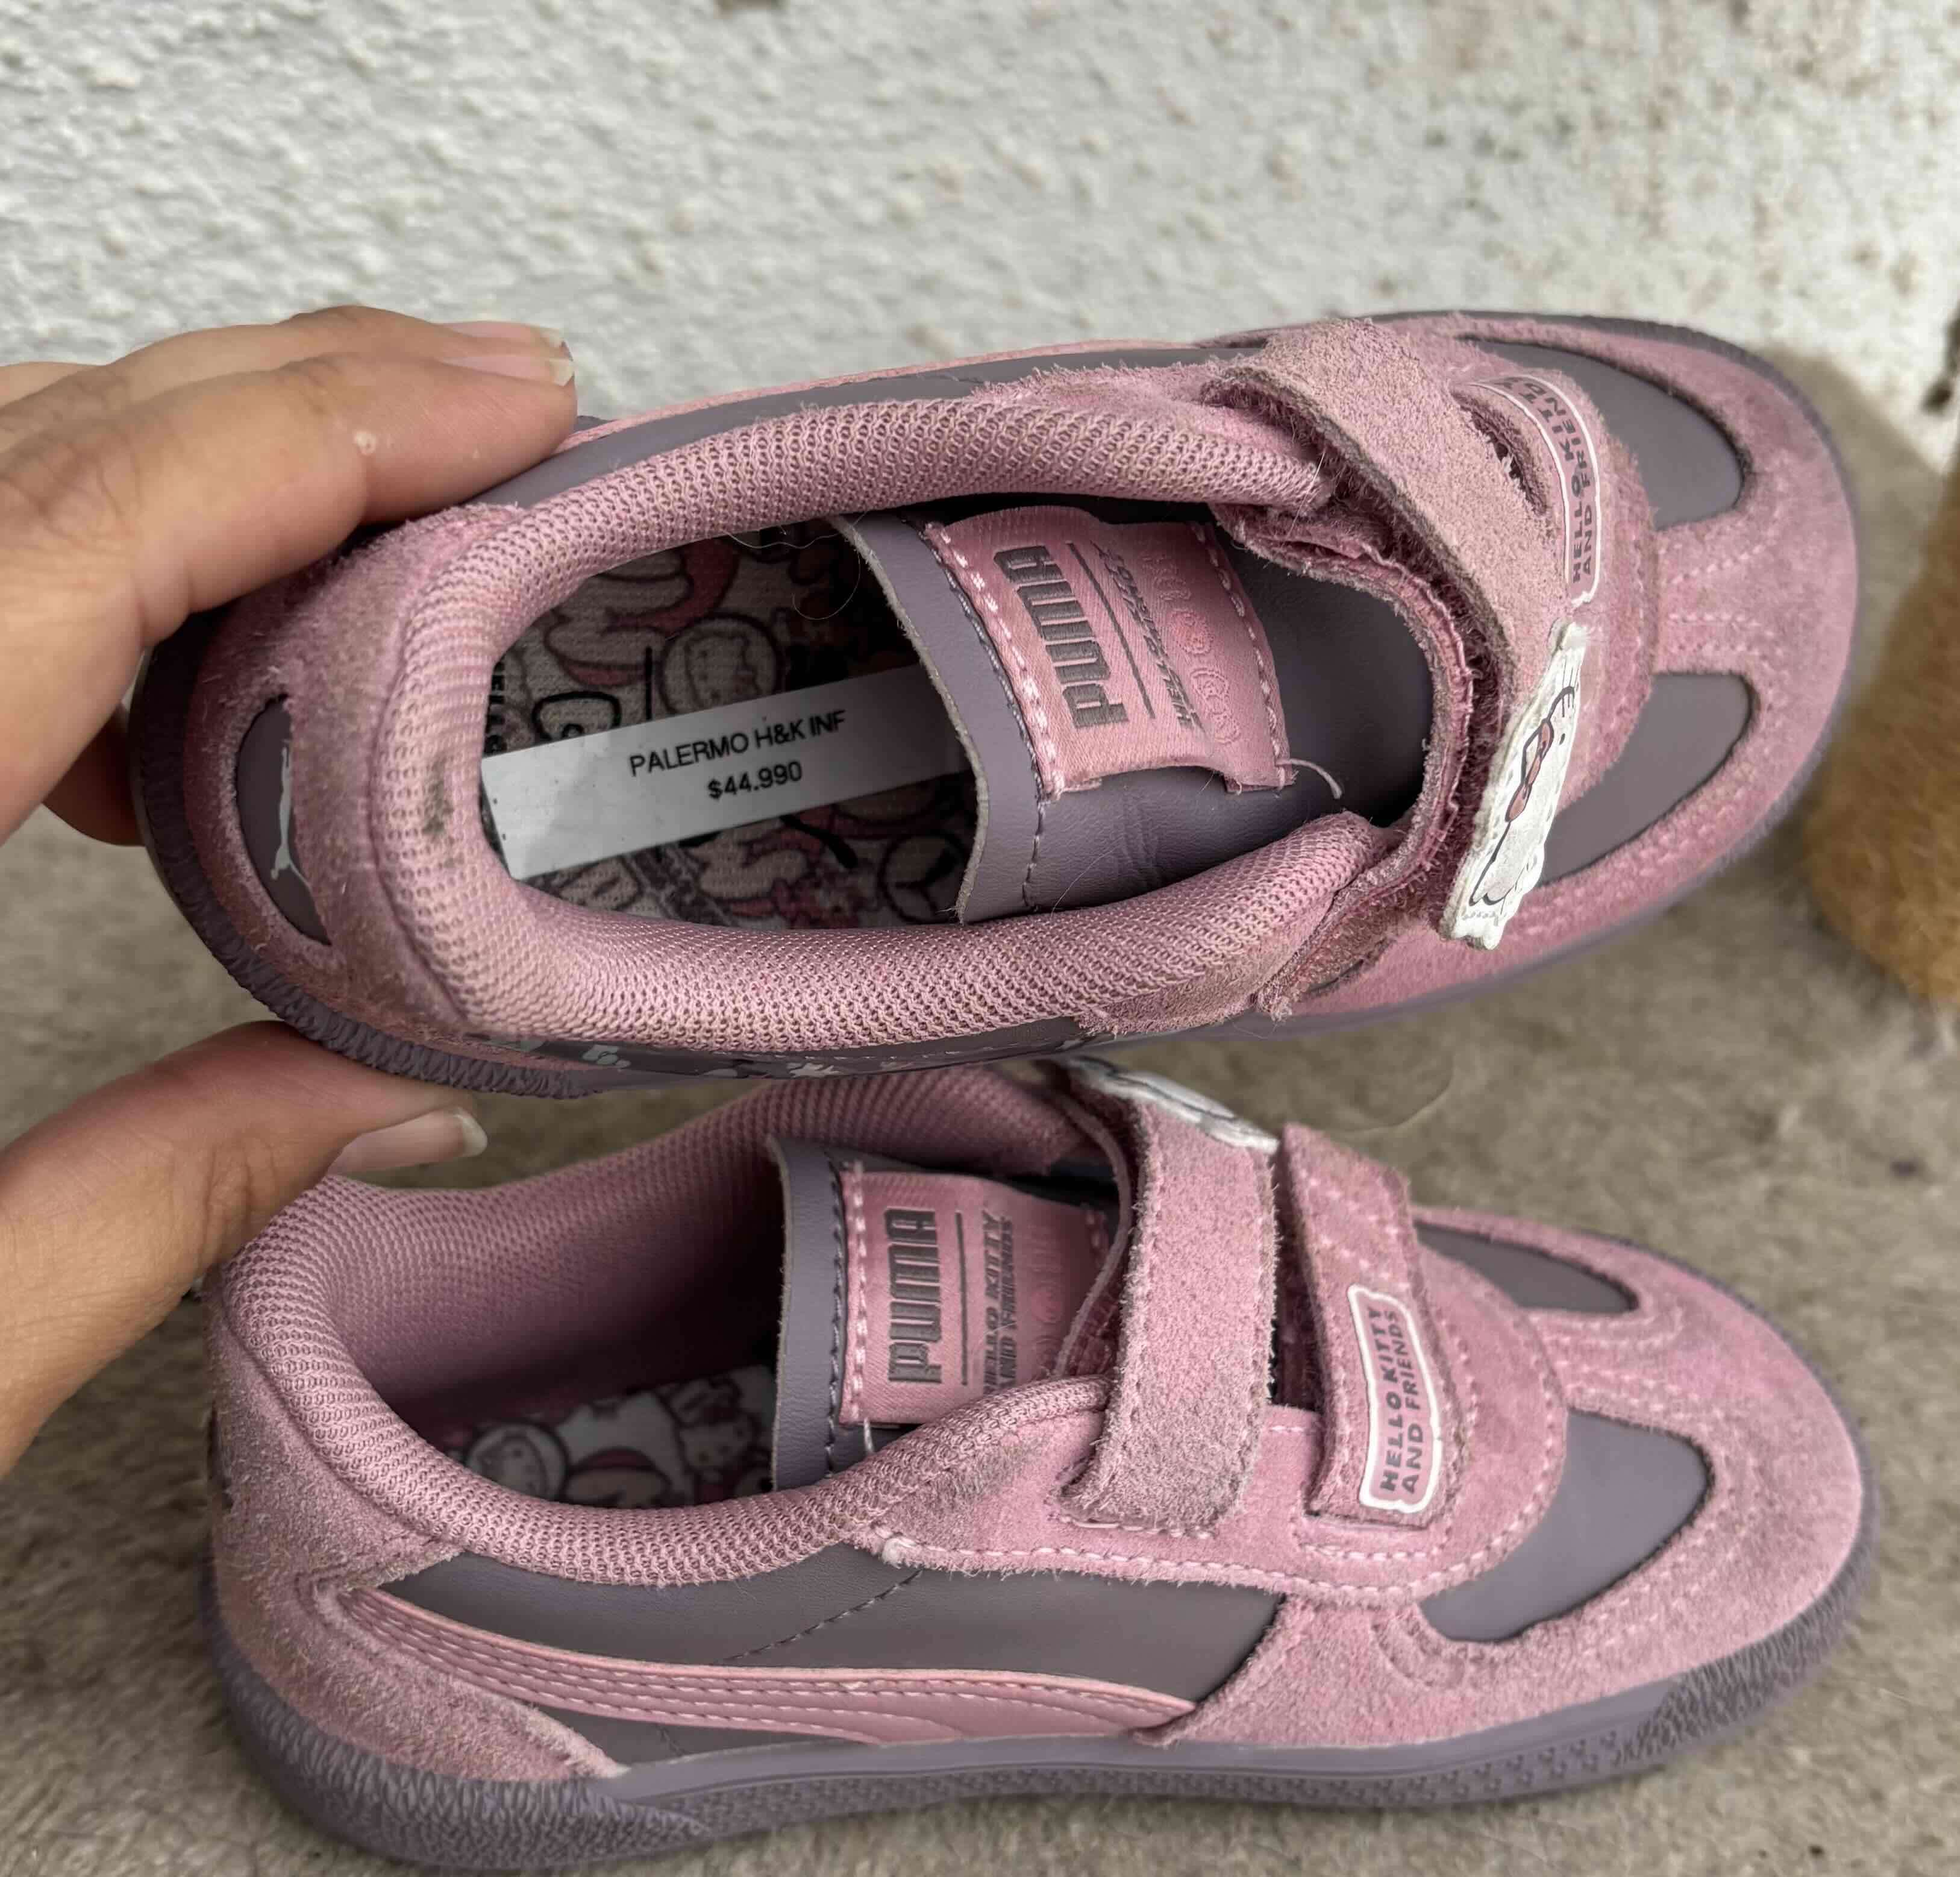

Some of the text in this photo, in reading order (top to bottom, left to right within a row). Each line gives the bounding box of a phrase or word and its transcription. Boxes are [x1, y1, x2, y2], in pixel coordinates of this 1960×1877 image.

[1571, 472, 1585, 583] HELLO
[1583, 505, 1593, 575] AND
[993, 545, 1130, 728] PUMA
[630, 709, 846, 777] PALERMO H&K INF
[707, 760, 803, 800] $44.990
[885, 1208, 942, 1384] PUMA
[982, 1209, 1000, 1297] KITTY
[1368, 1307, 1403, 1492] HELLO KITTY
[1385, 1310, 1423, 1494] AND FRIENDS
